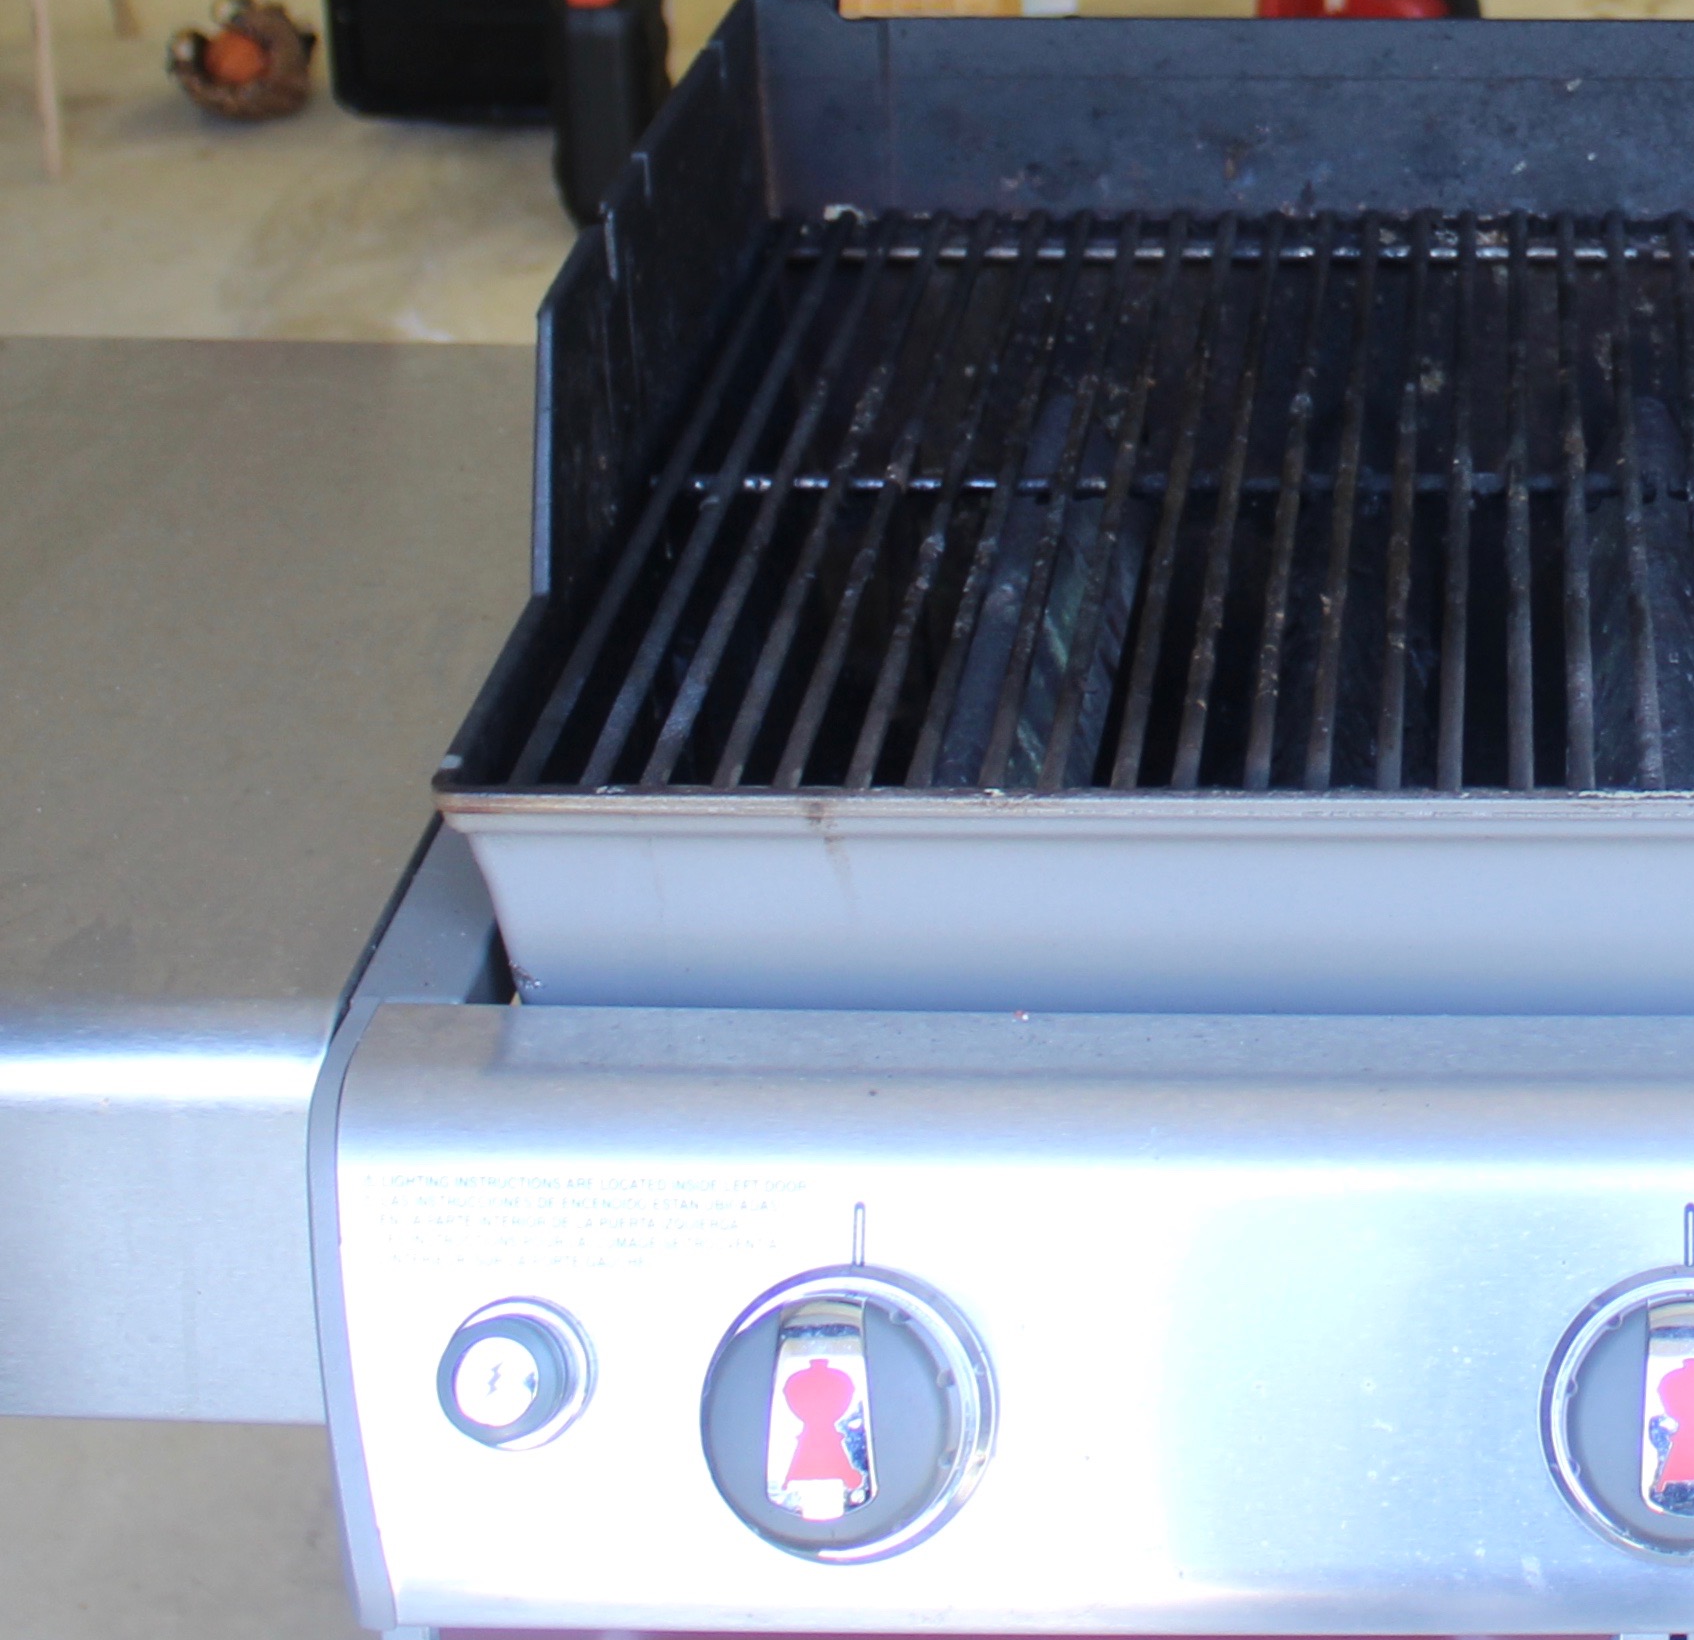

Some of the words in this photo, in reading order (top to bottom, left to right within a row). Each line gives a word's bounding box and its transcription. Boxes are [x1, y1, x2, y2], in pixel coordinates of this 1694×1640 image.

[382, 1175, 449, 1189] LIGHTING
[454, 1175, 562, 1190] INSTRUCTIONS
[566, 1177, 594, 1191] ARE
[600, 1178, 667, 1192] LOCATED
[672, 1178, 717, 1192] INSIDE
